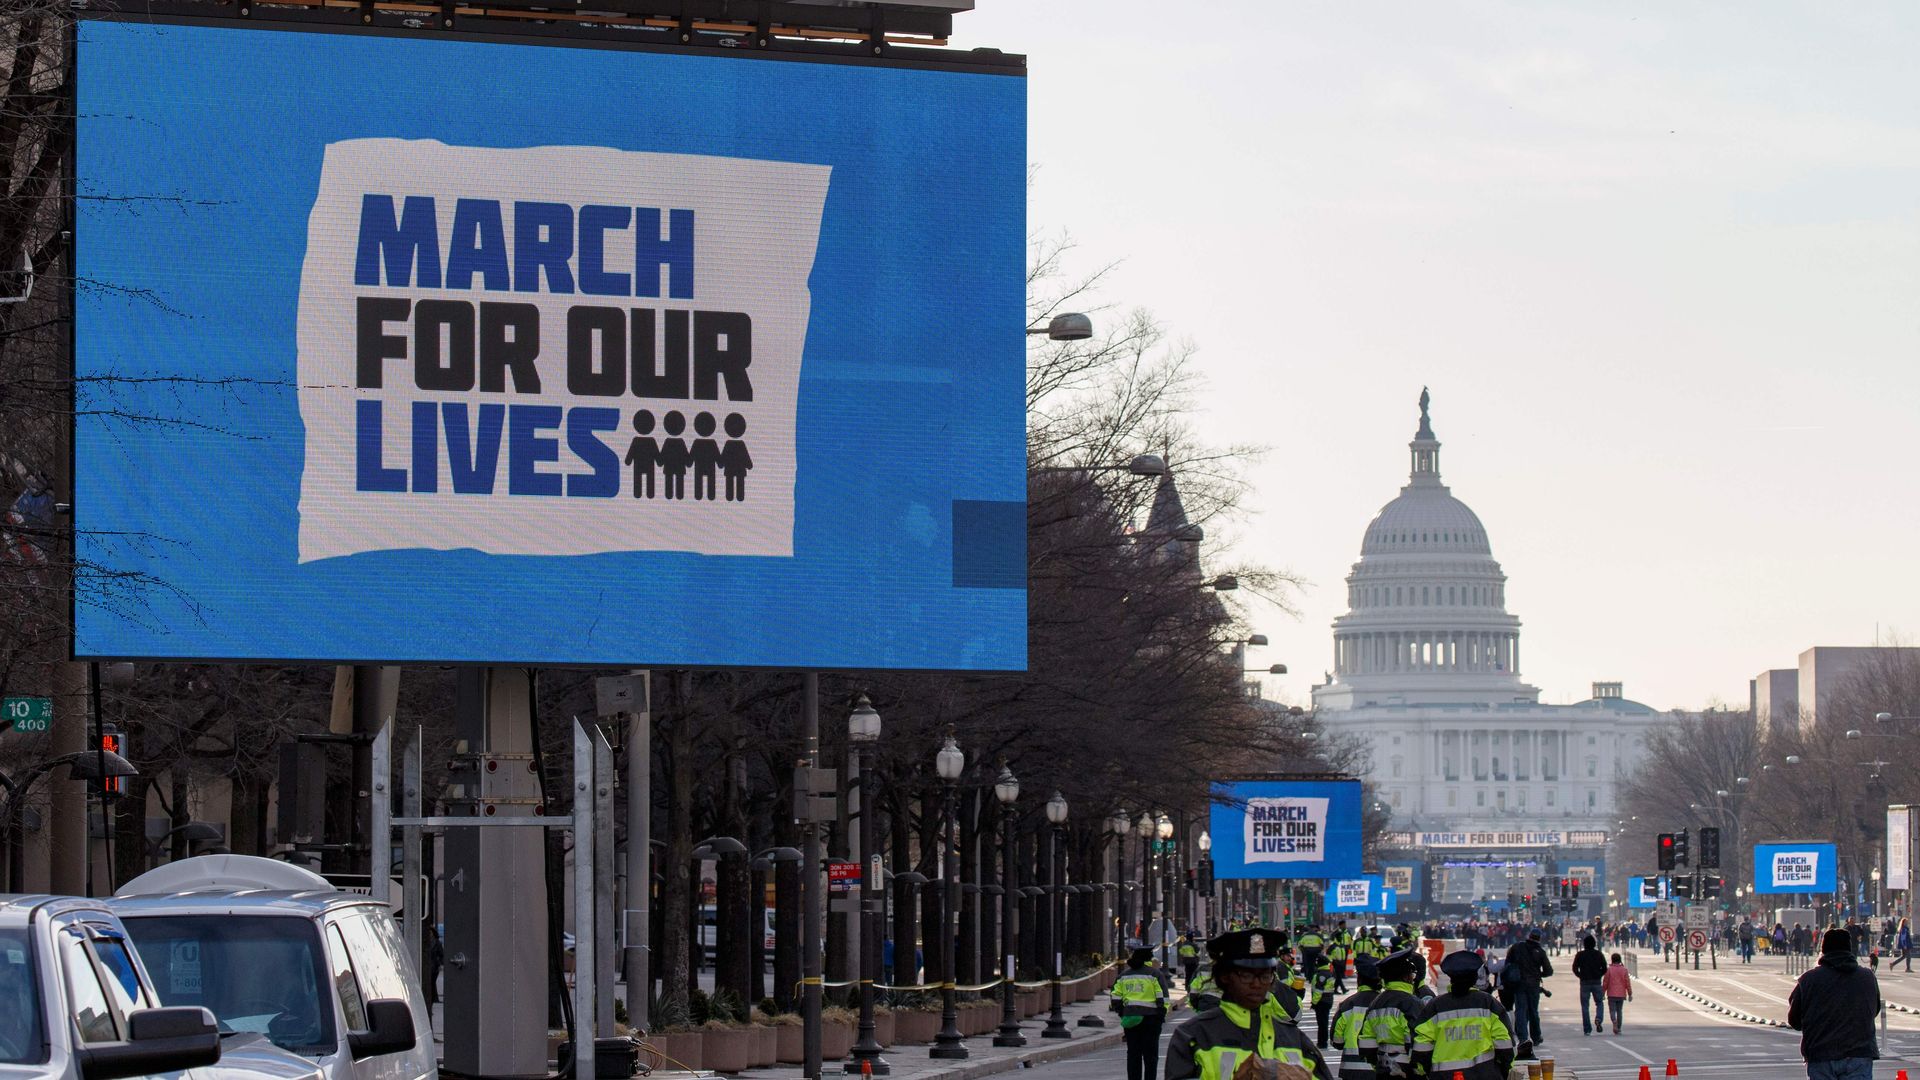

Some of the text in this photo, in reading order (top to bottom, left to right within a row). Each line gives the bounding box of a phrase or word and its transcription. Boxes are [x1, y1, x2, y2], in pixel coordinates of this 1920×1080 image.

[354, 193, 694, 299] MARCH
[356, 296, 753, 402] FOR OUR
[356, 399, 620, 498] LIVES
[8, 701, 30, 717] 10
[17, 719, 46, 731] 400
[1252, 806, 1307, 821] MARCH
[1253, 822, 1317, 837] FOR OUR
[1253, 838, 1295, 852] LIVES
[1421, 833, 1561, 844] MARCH FOR OUR LIVES
[1777, 865, 1793, 873] FOR
[1777, 873, 1800, 881] LIVES
[1444, 1024, 1483, 1042] POLICE
